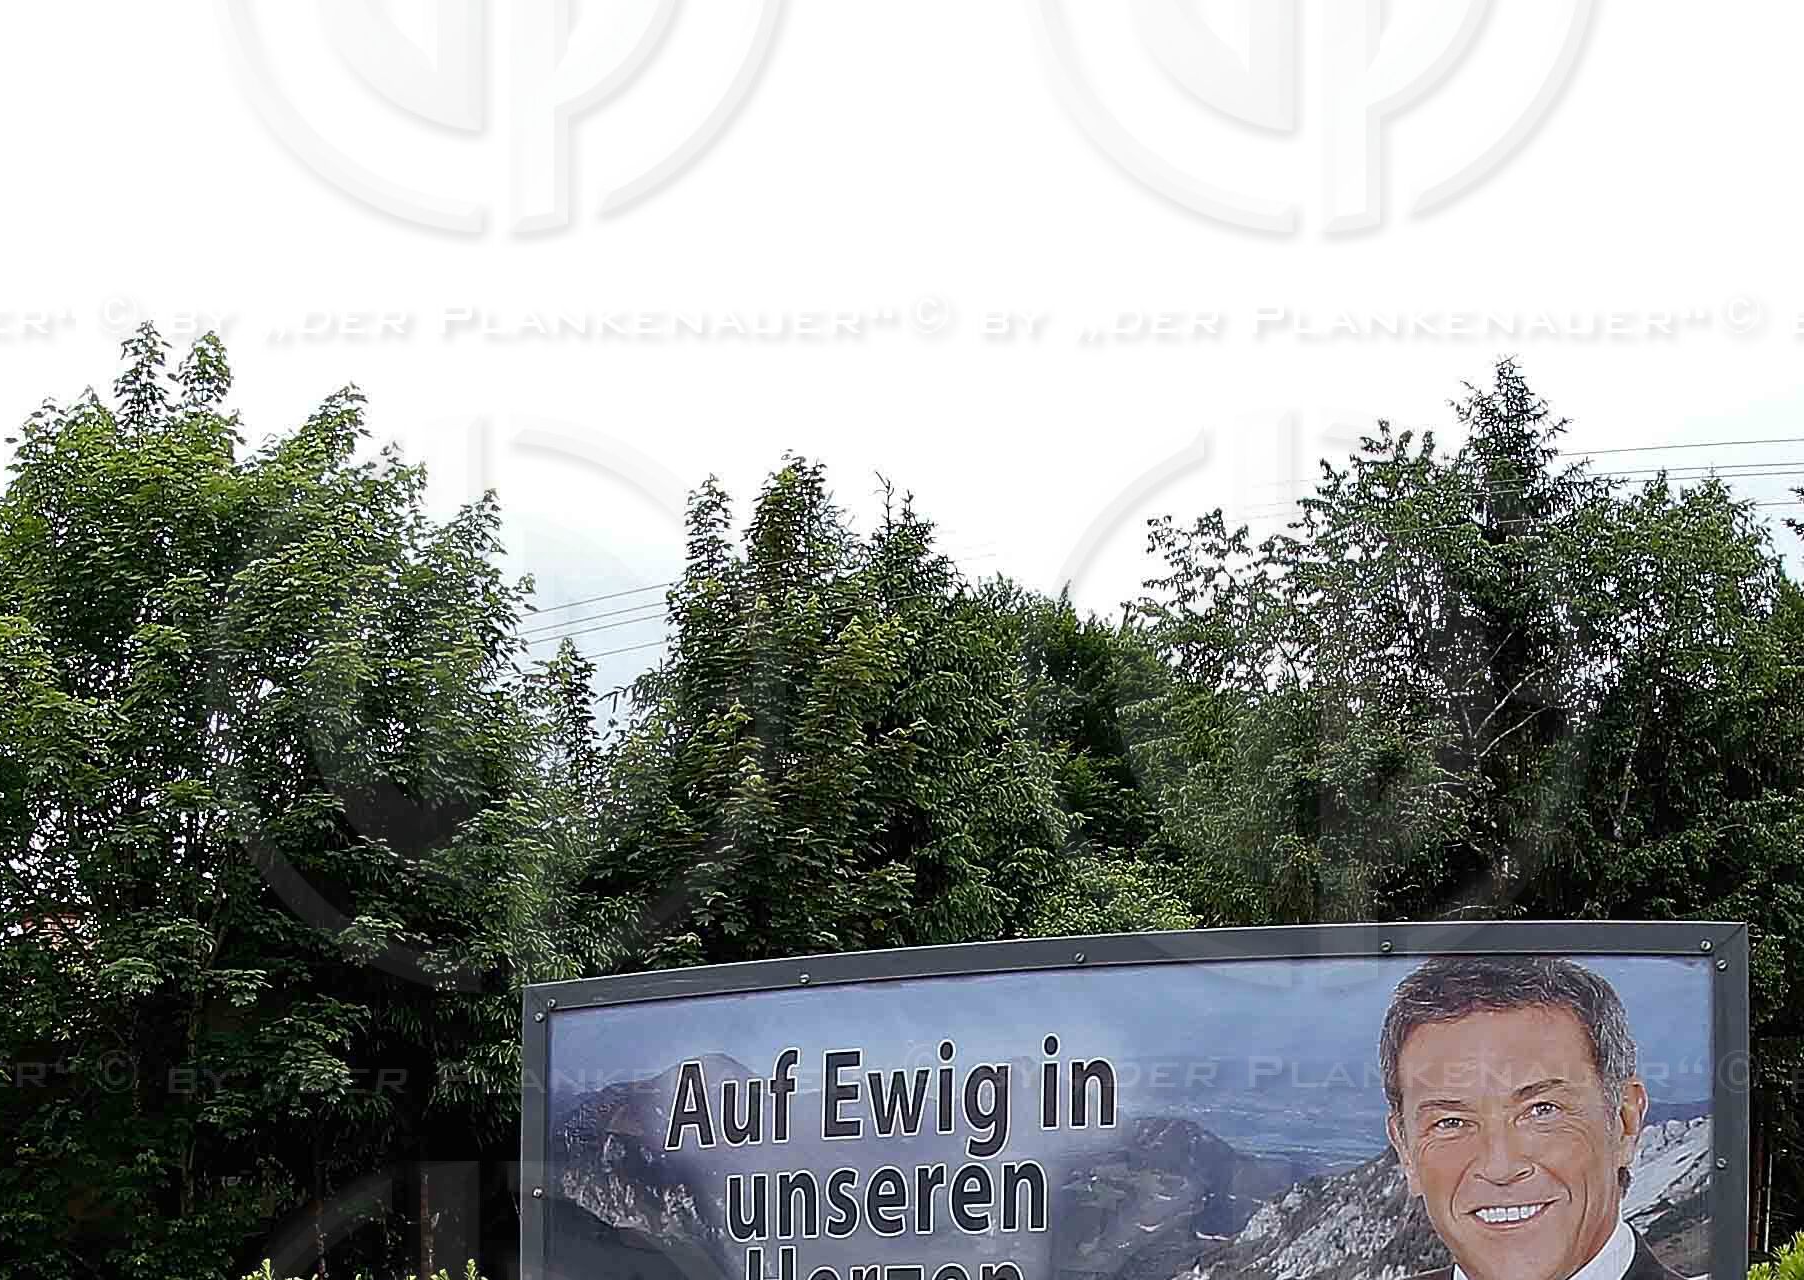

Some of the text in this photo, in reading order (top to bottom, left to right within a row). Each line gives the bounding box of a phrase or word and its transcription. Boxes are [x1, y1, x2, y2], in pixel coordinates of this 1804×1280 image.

[663, 1032, 1118, 1156] Auf Ewig in
[727, 1159, 1050, 1245] unseren
